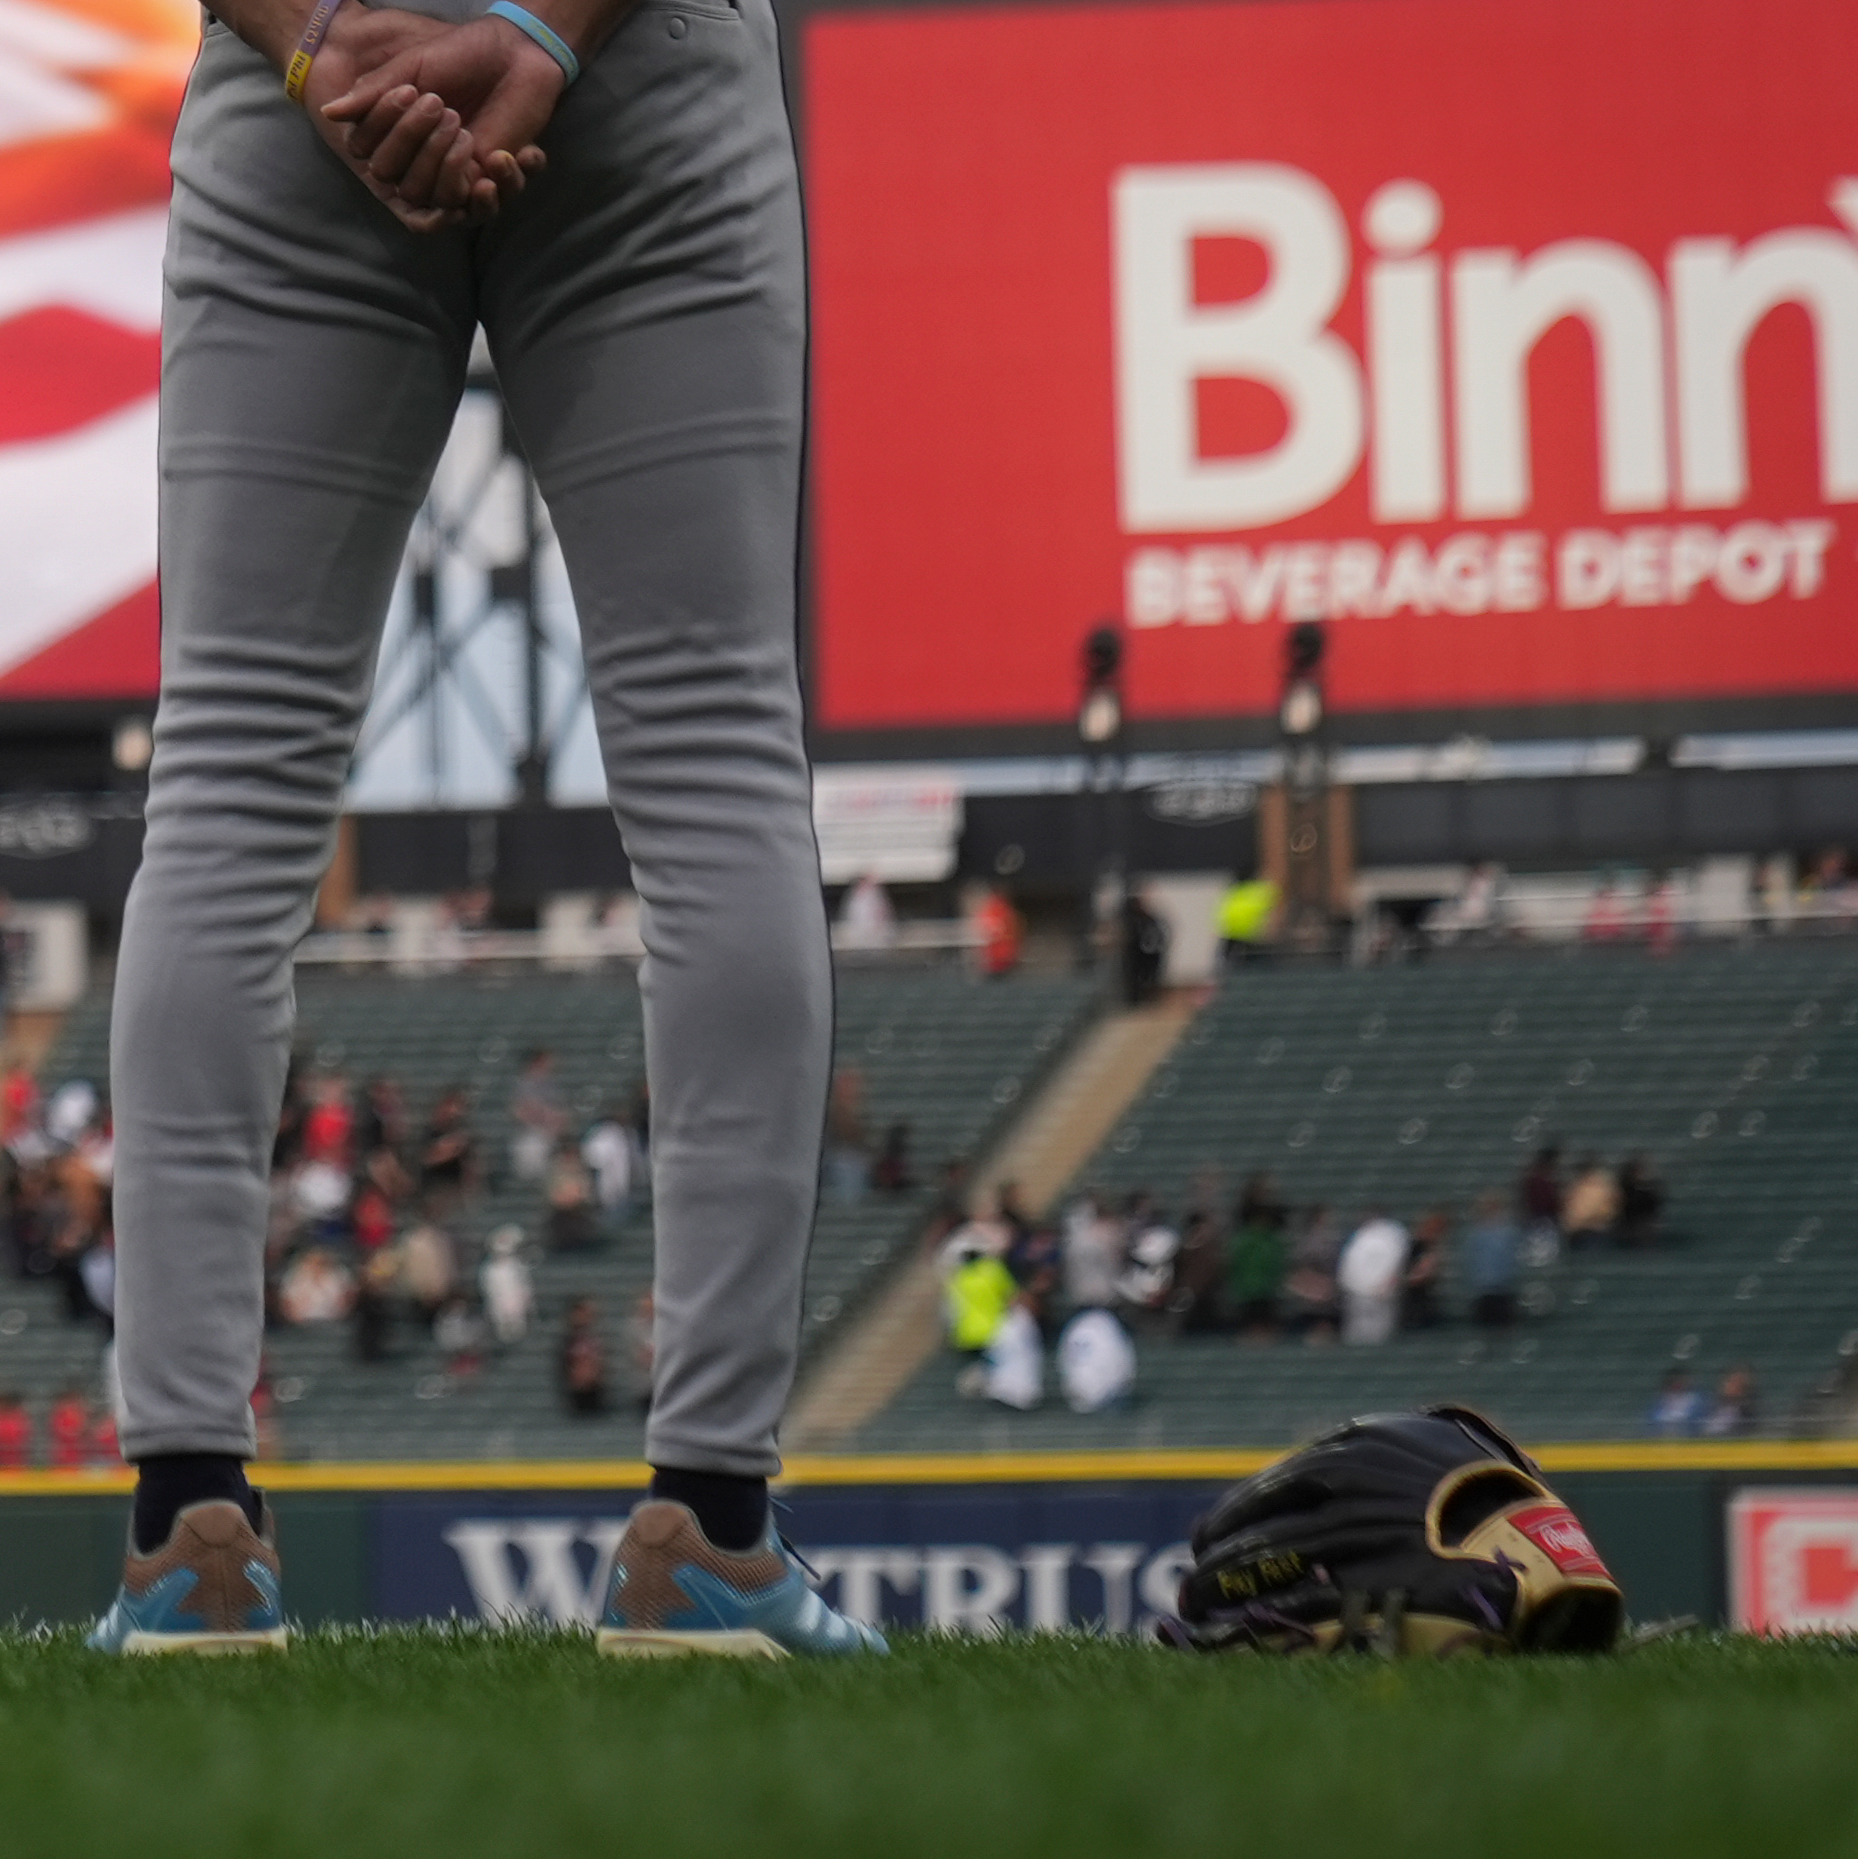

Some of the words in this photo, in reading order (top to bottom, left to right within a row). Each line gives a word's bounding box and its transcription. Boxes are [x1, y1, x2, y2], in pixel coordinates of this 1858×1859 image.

[1109, 160, 1858, 534] Binn
[1126, 533, 1547, 628] BEVERAGE
[1556, 520, 1836, 614] DEPOT
